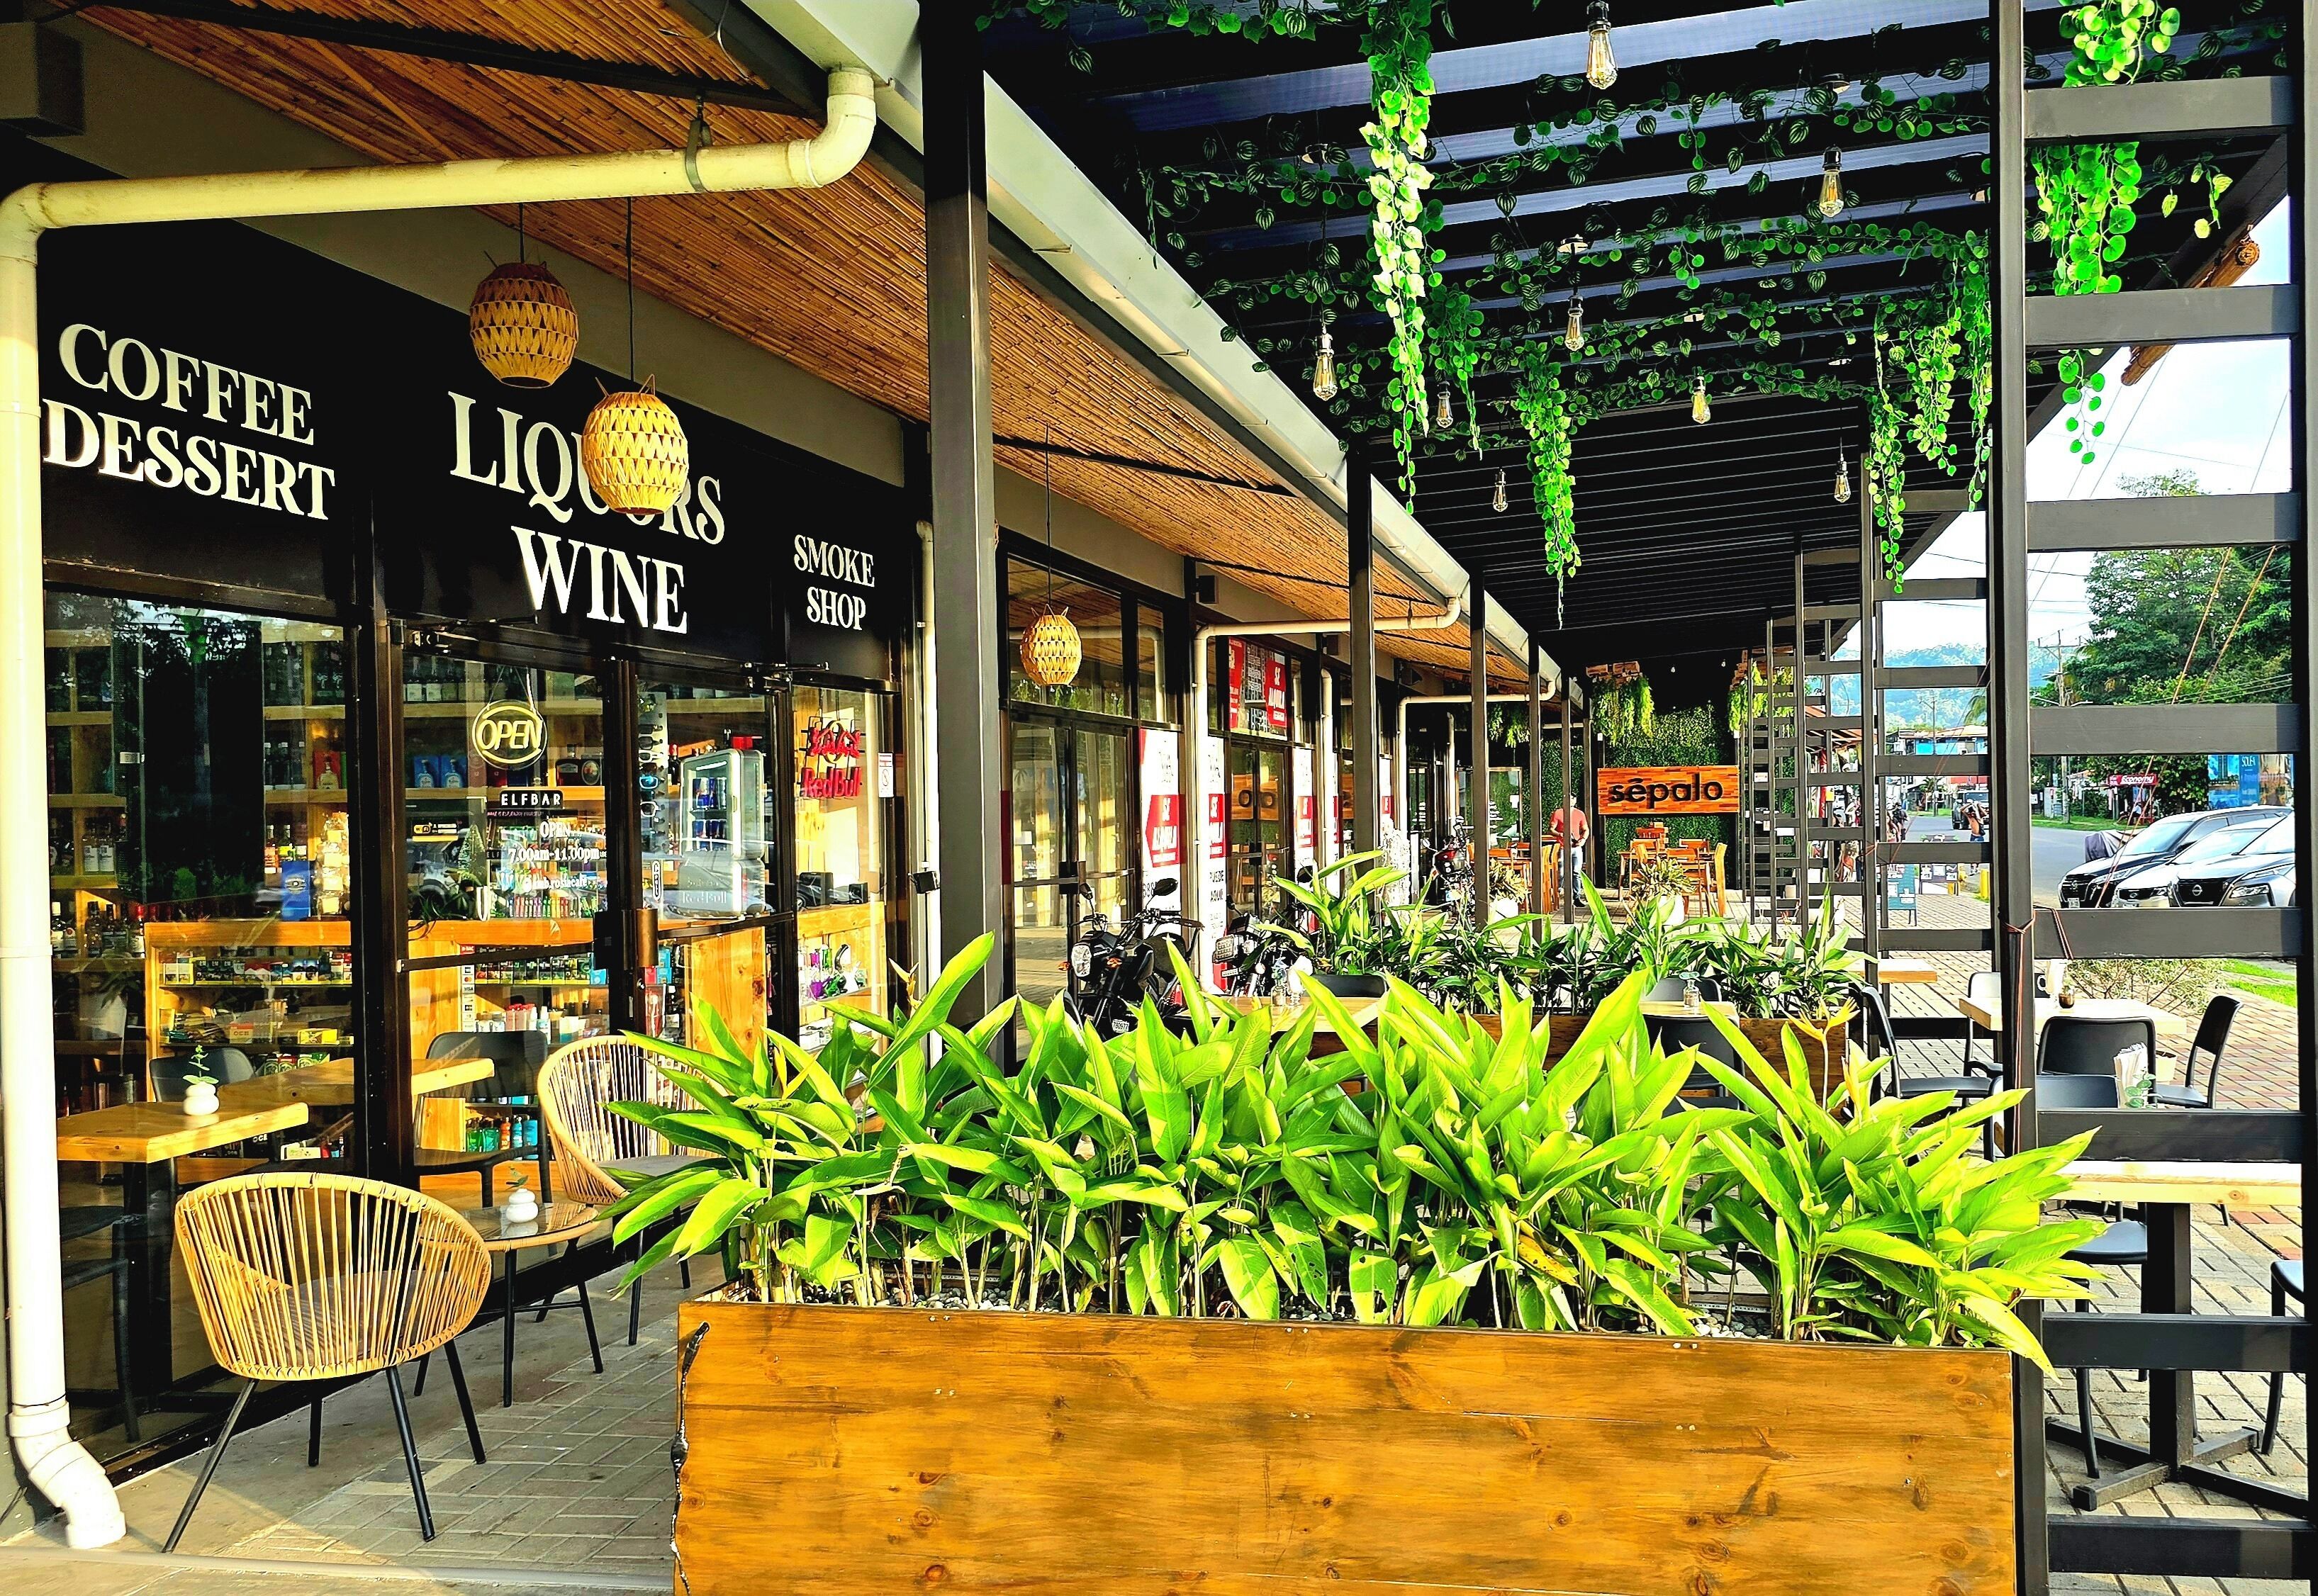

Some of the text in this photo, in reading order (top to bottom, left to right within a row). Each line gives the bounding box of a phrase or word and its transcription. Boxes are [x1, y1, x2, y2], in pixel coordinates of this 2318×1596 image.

[59, 323, 315, 446] COFFEE
[42, 398, 335, 521] DESSERT
[447, 390, 725, 545] LIQURS
[510, 525, 688, 634] WINE
[793, 534, 875, 588] SMOKE
[806, 586, 867, 631] SHOP
[476, 719, 543, 751] OPEN
[500, 793, 561, 807] ELFBAR
[540, 821, 571, 838] OPEN
